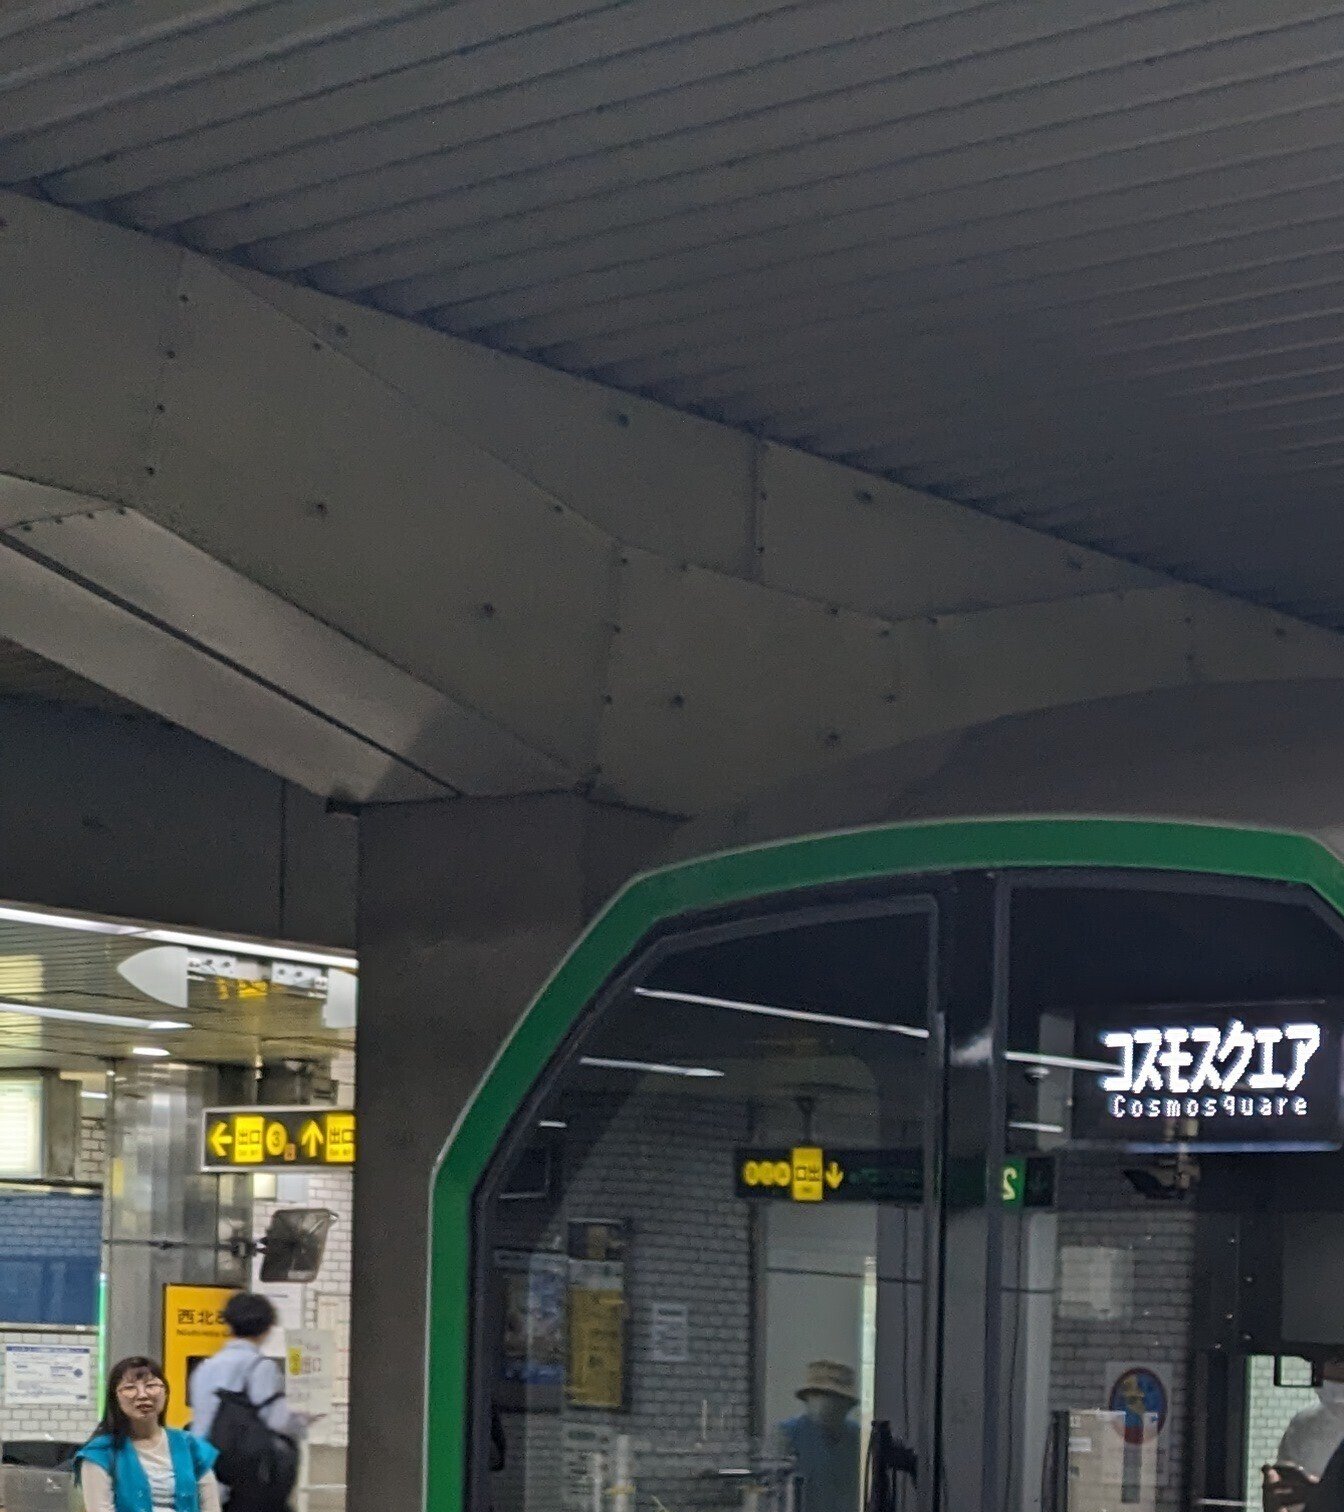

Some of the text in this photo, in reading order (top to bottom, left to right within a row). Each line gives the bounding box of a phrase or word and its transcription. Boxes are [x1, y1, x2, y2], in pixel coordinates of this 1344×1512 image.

[1102, 1018, 1321, 1093] コスモスクエア
[1111, 1095, 1308, 1118] Cosmosquare
